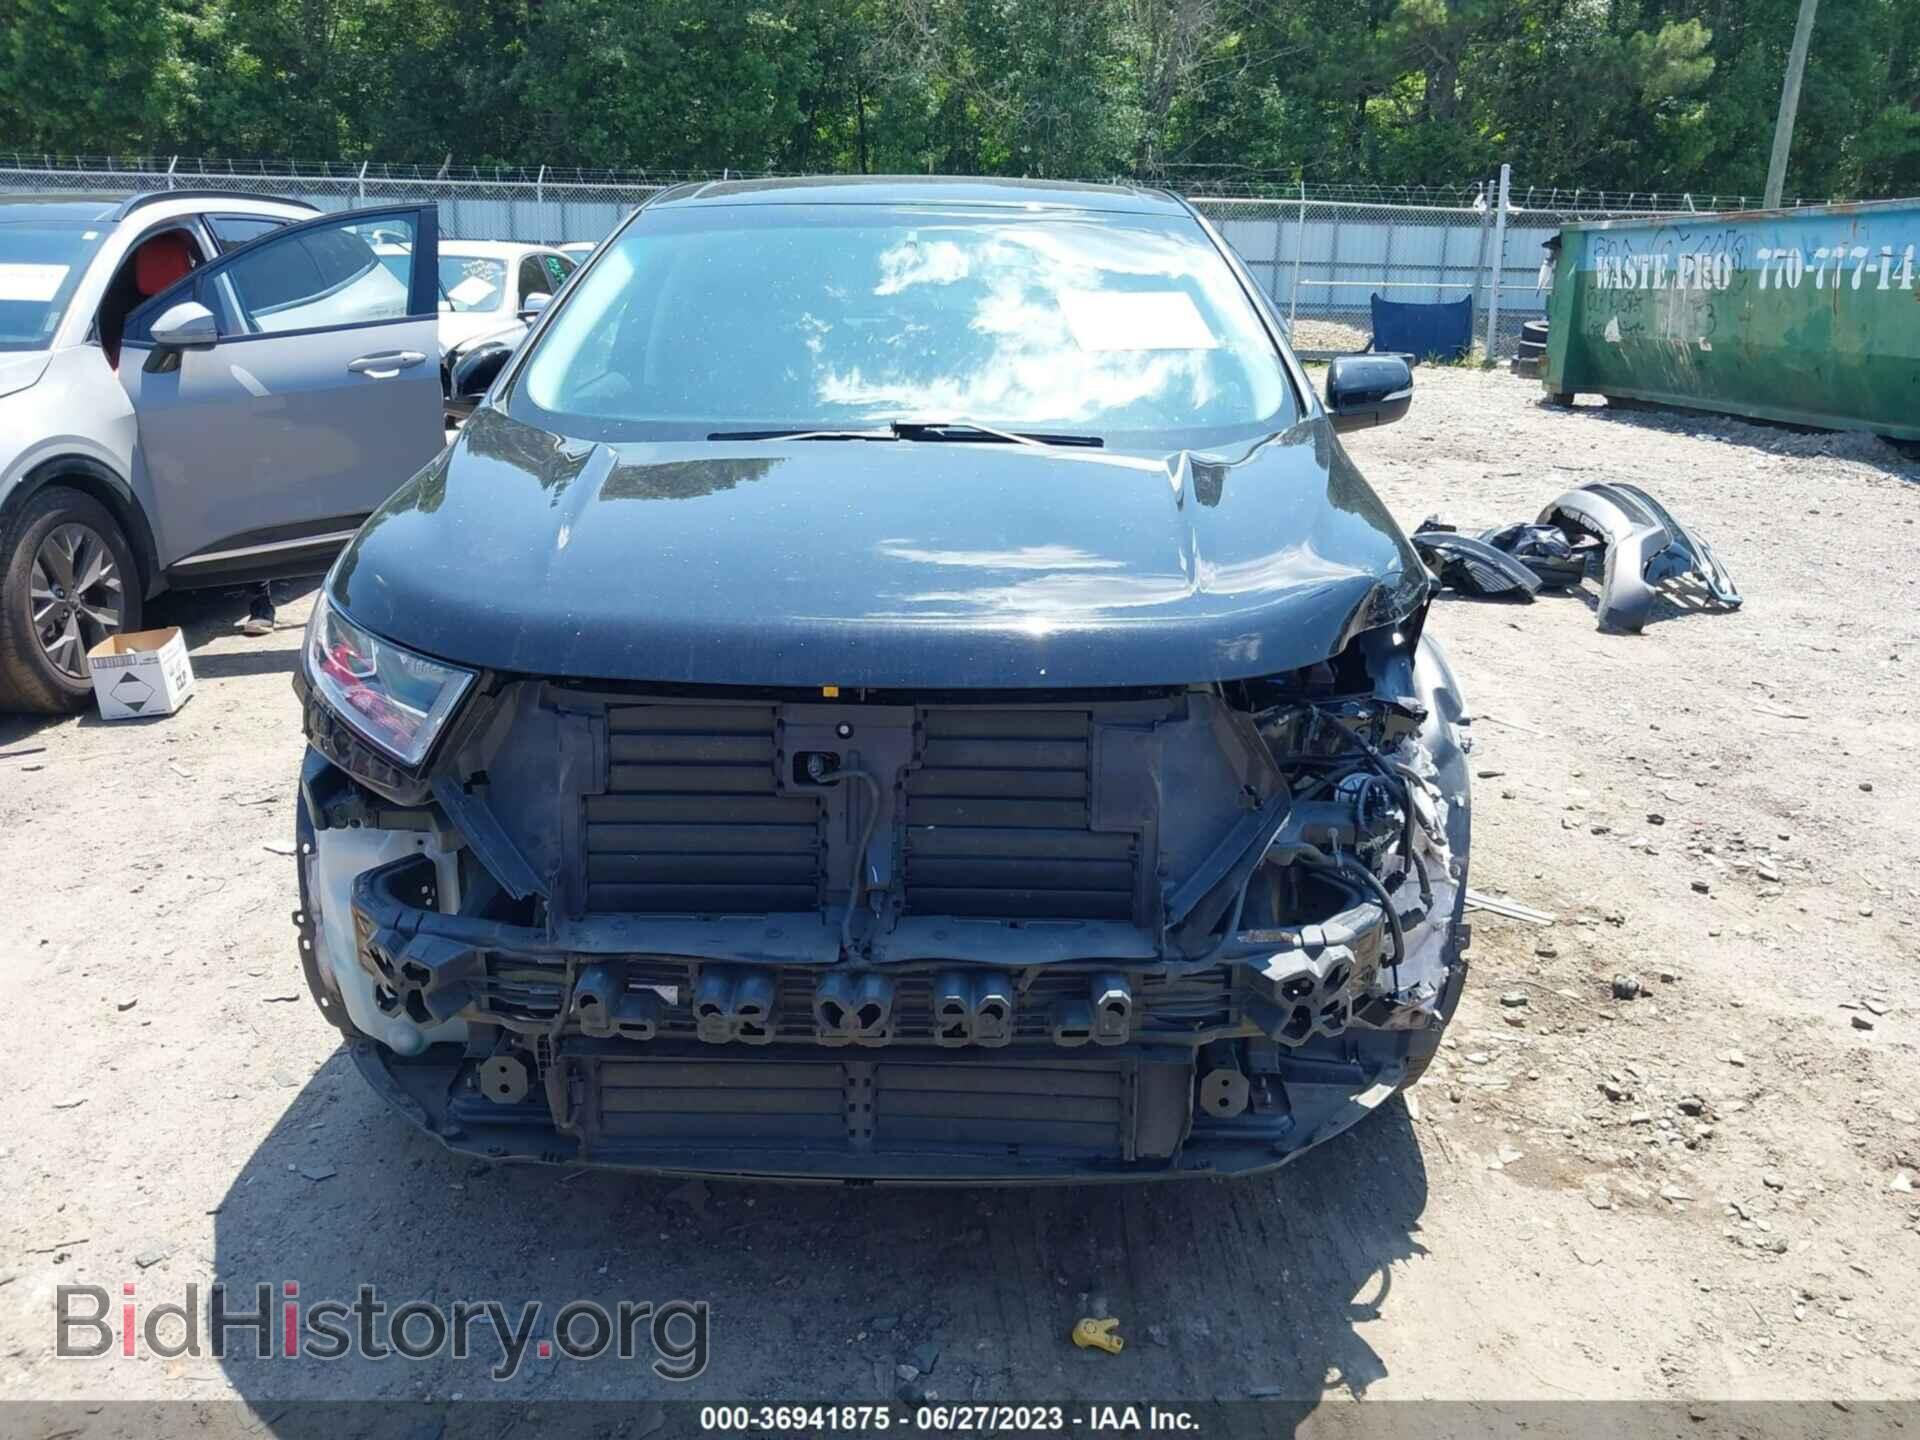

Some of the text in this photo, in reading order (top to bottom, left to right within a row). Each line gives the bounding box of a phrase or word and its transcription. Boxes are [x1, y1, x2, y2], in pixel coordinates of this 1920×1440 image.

[1595, 244, 1920, 291] WASTE PRO 770-777-14
